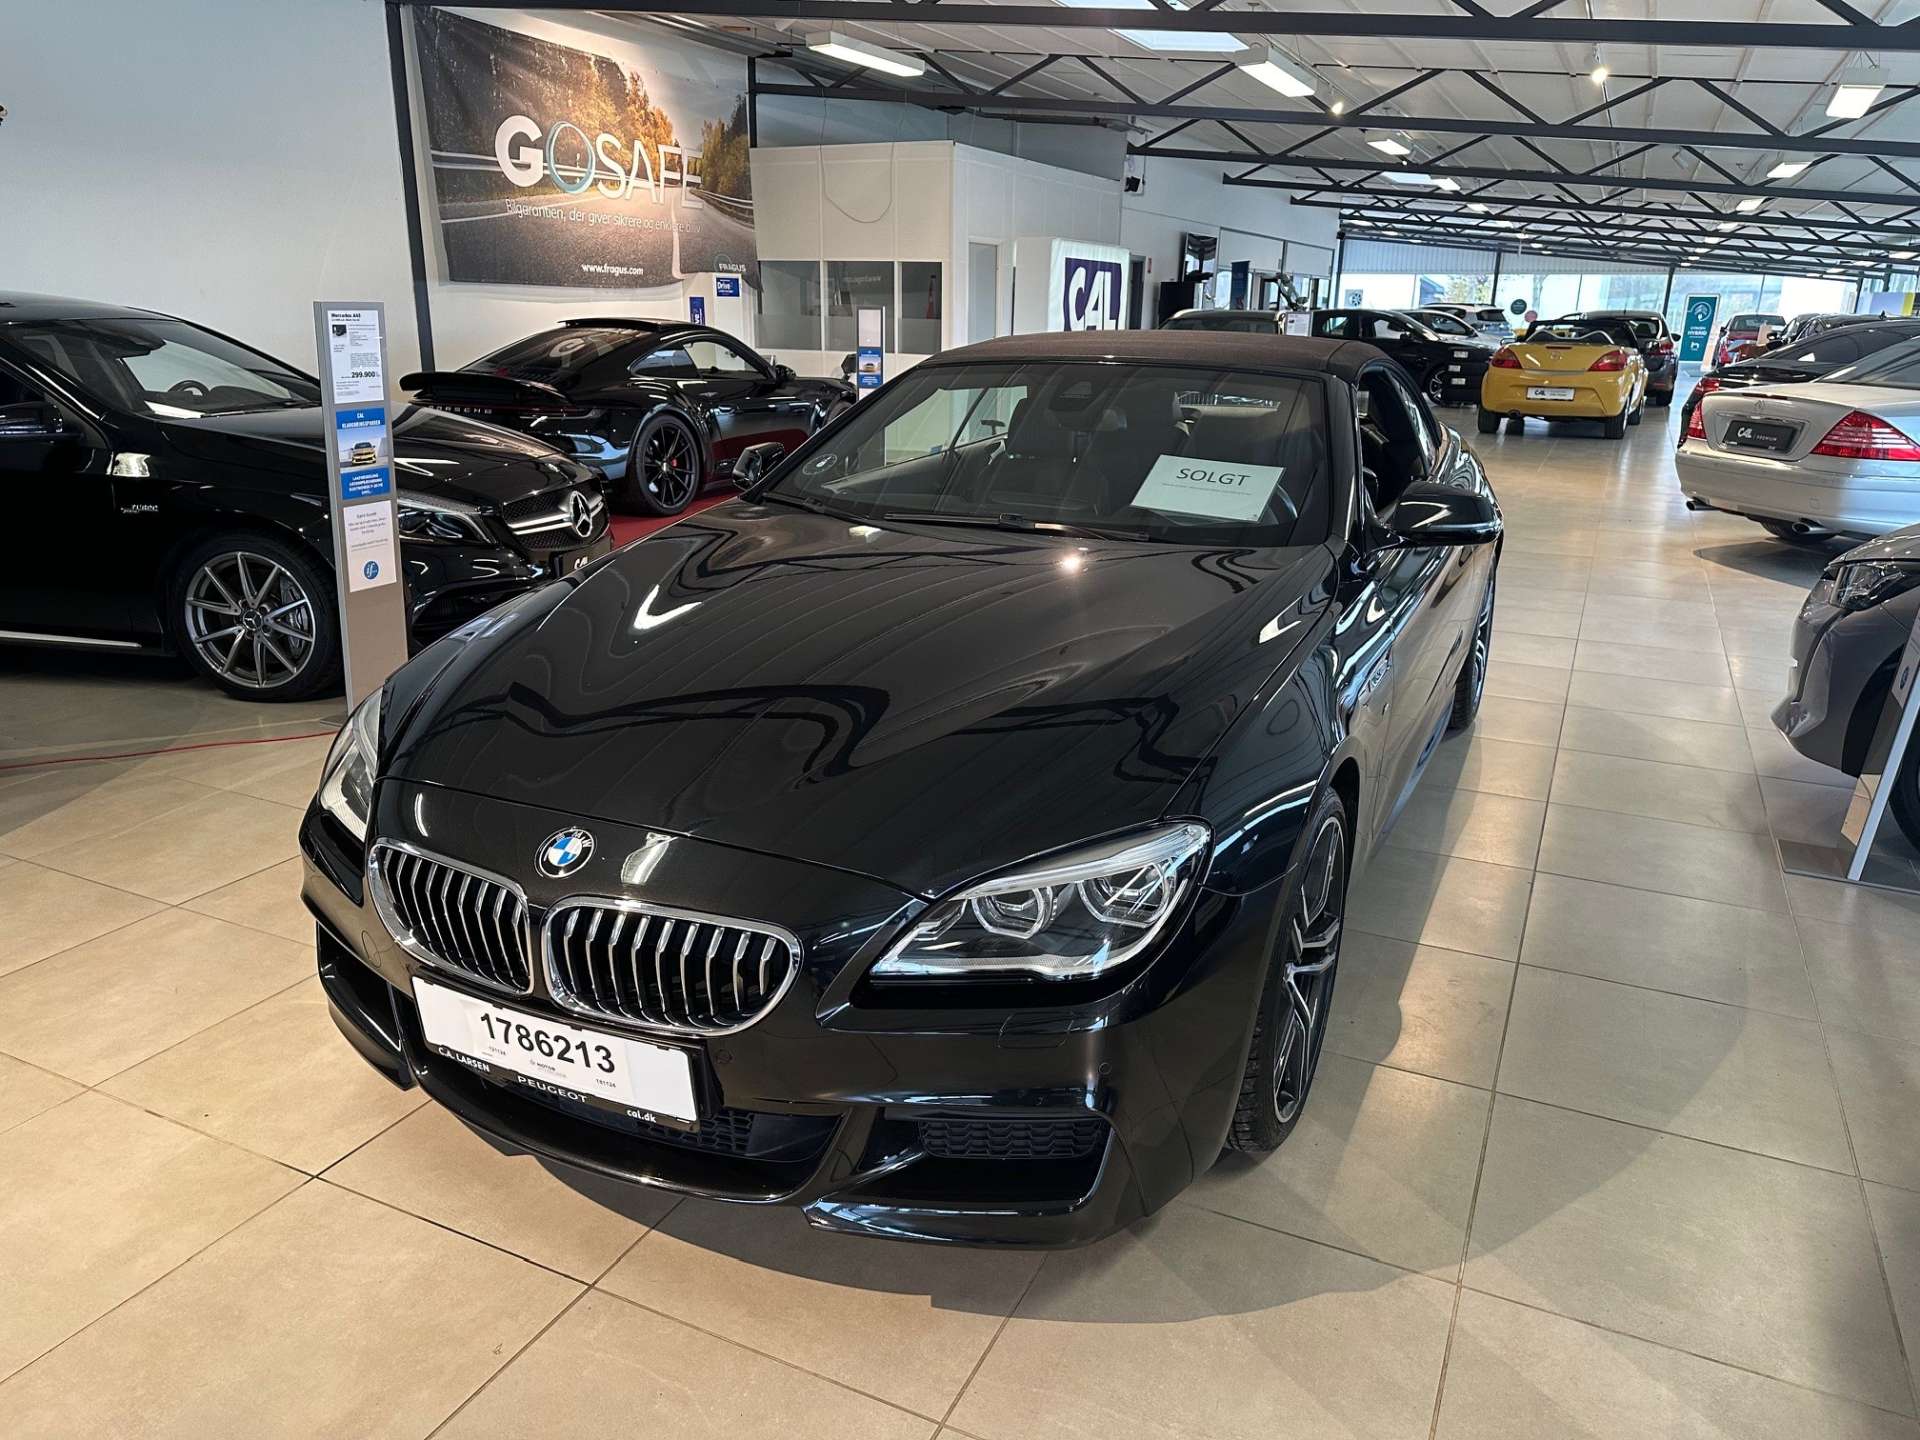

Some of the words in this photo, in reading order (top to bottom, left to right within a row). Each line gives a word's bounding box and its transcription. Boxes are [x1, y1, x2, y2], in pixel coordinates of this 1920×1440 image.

[495, 115, 704, 209] GOSAFE
[505, 199, 566, 223] Bilgarantien,
[569, 208, 585, 221] der
[588, 212, 611, 226] giver
[581, 263, 643, 276] www.fragus.com
[719, 263, 746, 272] FRAGUS
[1068, 266, 1117, 331] CAL
[1176, 468, 1252, 486] SOLGT
[480, 1012, 616, 1074] 1786213
[456, 1053, 490, 1073] LARSEN
[517, 1075, 587, 1103] PEUGEOT
[626, 1109, 657, 1123] cal.dk
